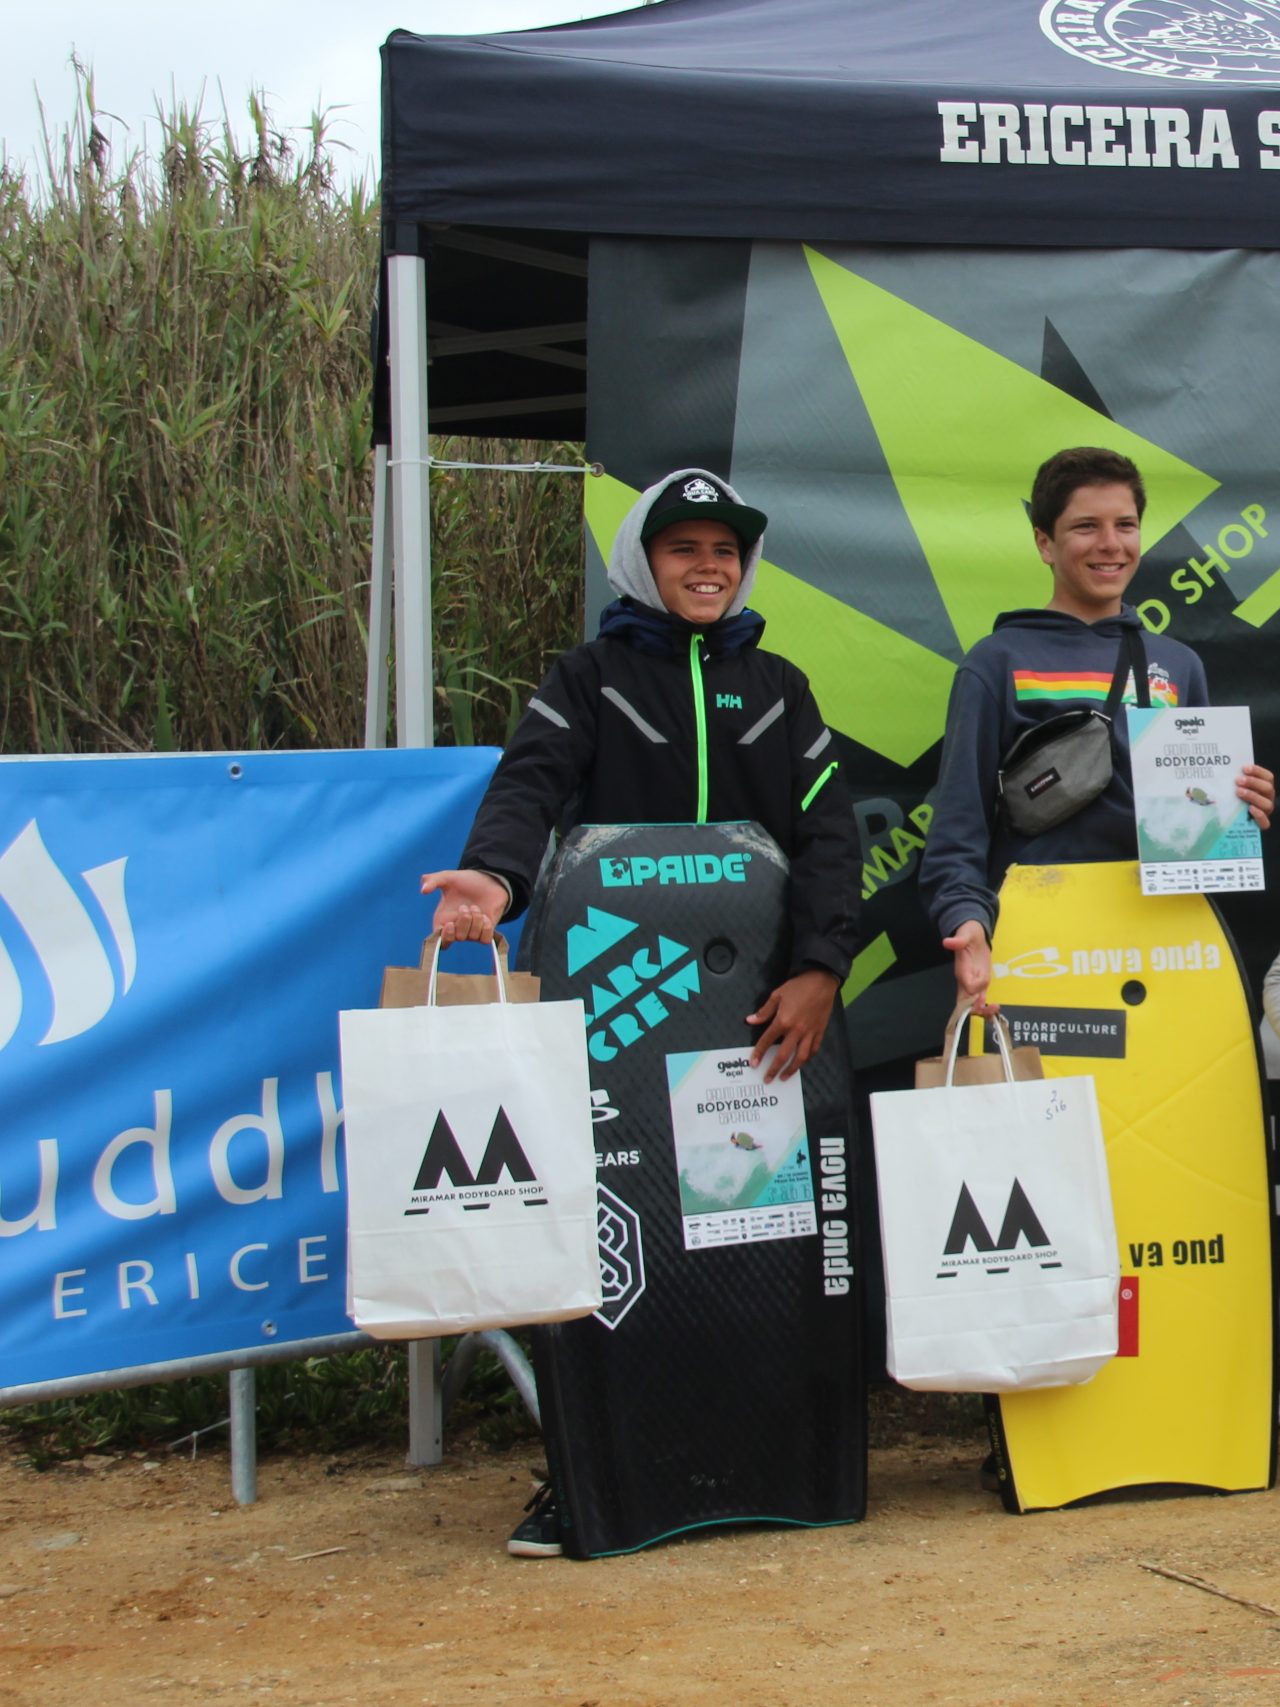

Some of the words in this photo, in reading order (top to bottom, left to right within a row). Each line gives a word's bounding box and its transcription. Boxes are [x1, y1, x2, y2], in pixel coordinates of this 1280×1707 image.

[937, 102, 1240, 170] ERICEIRA
[1170, 503, 1268, 604] SHOP
[716, 693, 742, 709] HH
[1155, 755, 1231, 767] BODYBOARD
[630, 853, 747, 886] PRIDE
[1072, 947, 1142, 975] nova
[1151, 940, 1221, 971] onda
[1013, 1021, 1118, 1035] BOARDCULTURE
[1013, 1032, 1057, 1042] STORE
[697, 1096, 778, 1114] BODYBOARD
[820, 1138, 848, 1211] nova
[411, 1193, 456, 1204] MIRAMAR
[459, 1188, 516, 1200] BODYBOARD
[519, 1186, 544, 1195] SHOP
[823, 1219, 854, 1296] onda
[941, 1258, 980, 1267] MIRAMAR
[982, 1254, 1033, 1264] BODYBOARD
[1035, 1250, 1058, 1259] SHOP
[54, 1235, 328, 1319] ERICE
